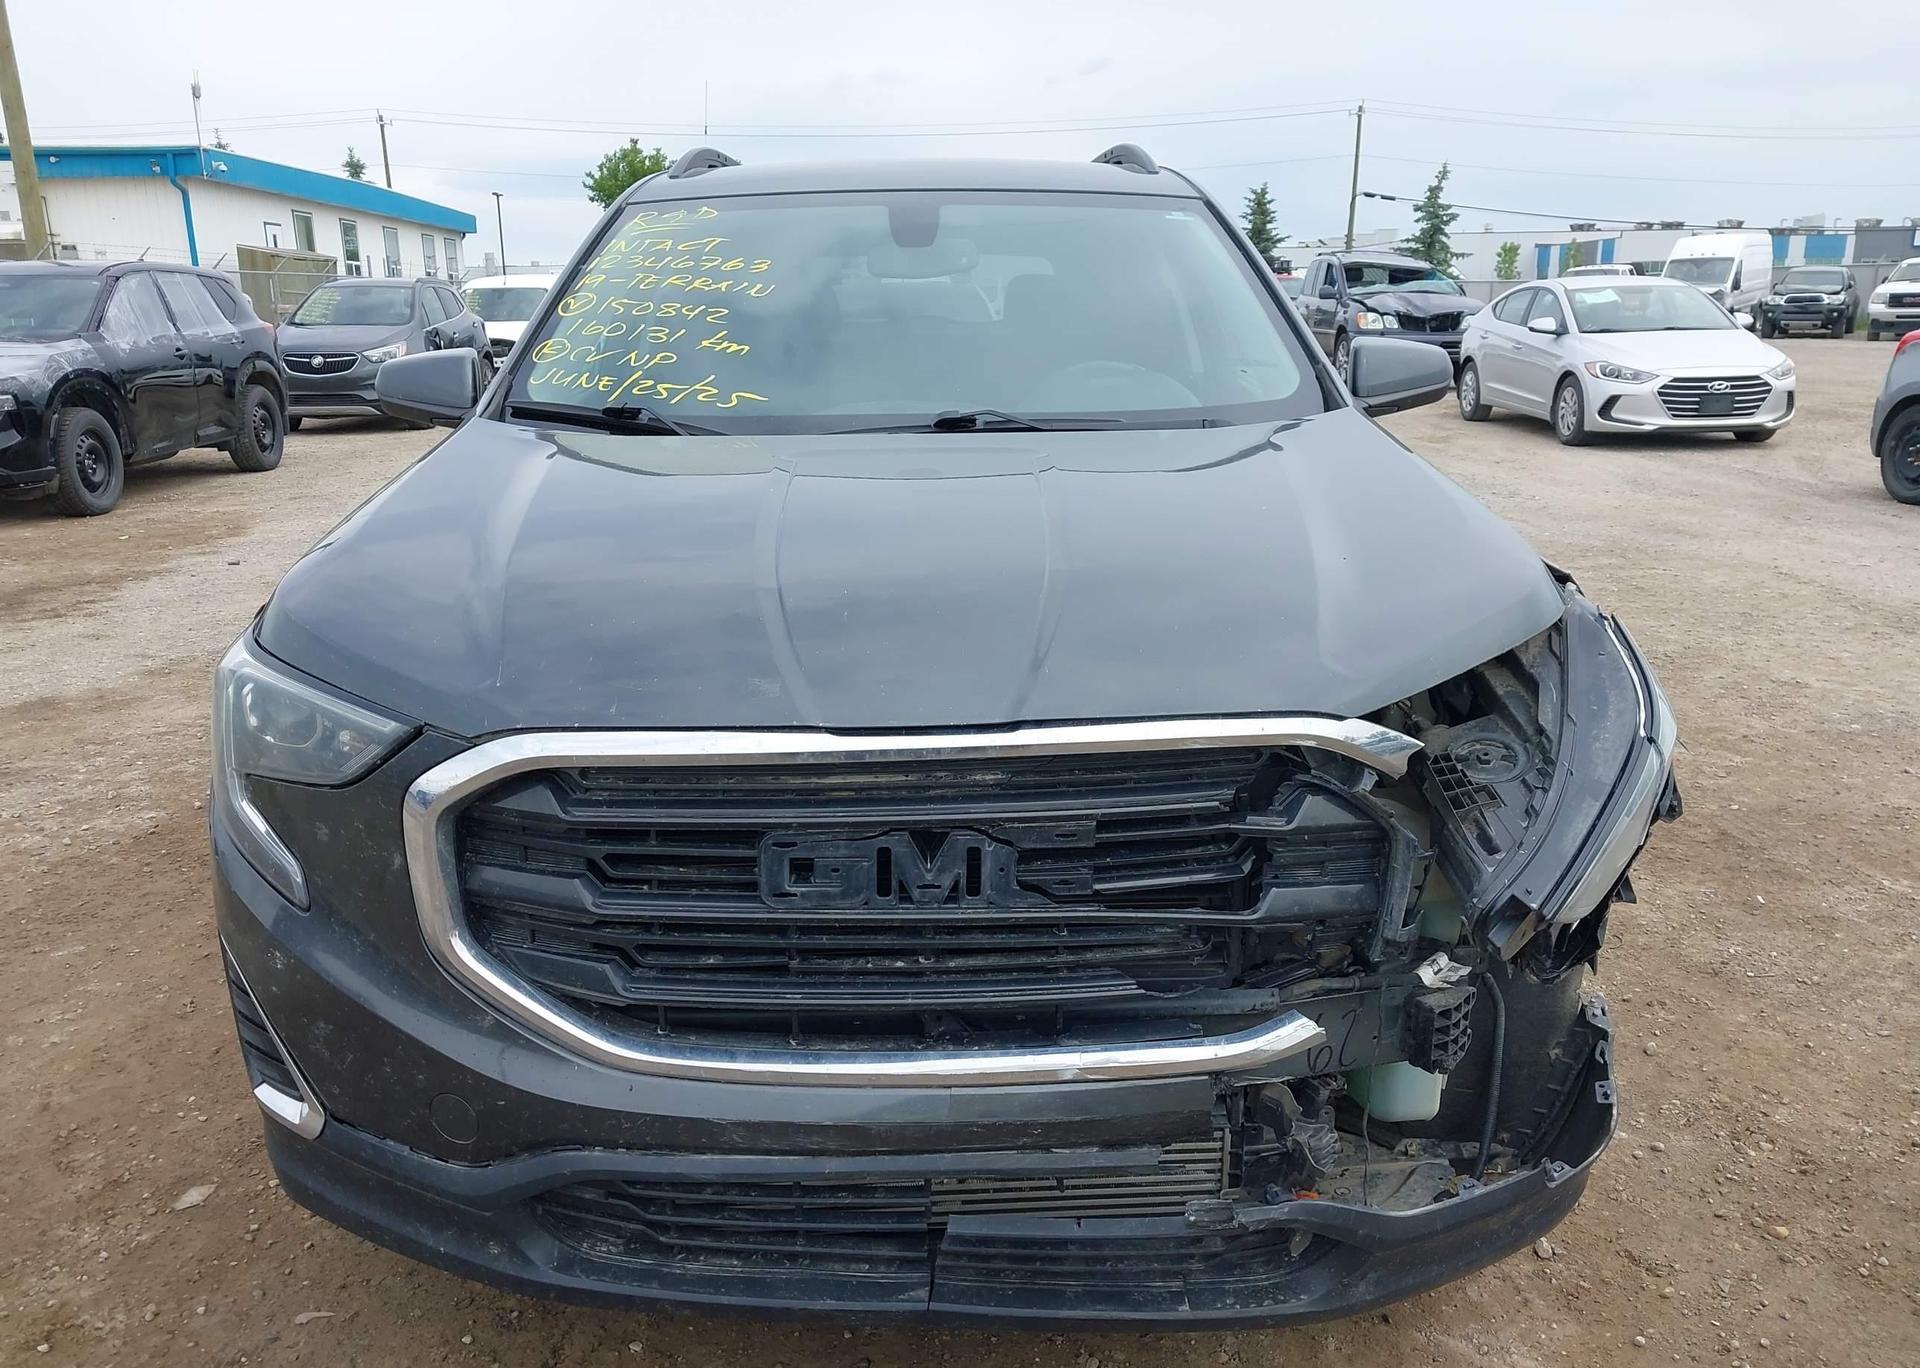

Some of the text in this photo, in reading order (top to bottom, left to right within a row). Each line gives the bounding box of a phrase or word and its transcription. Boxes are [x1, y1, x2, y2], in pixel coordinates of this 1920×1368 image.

[599, 237, 732, 255] INTACT
[585, 254, 772, 273] 12346763
[574, 273, 776, 298] 19-TERRAIN
[598, 296, 730, 324] 150842
[566, 318, 687, 343] 160131
